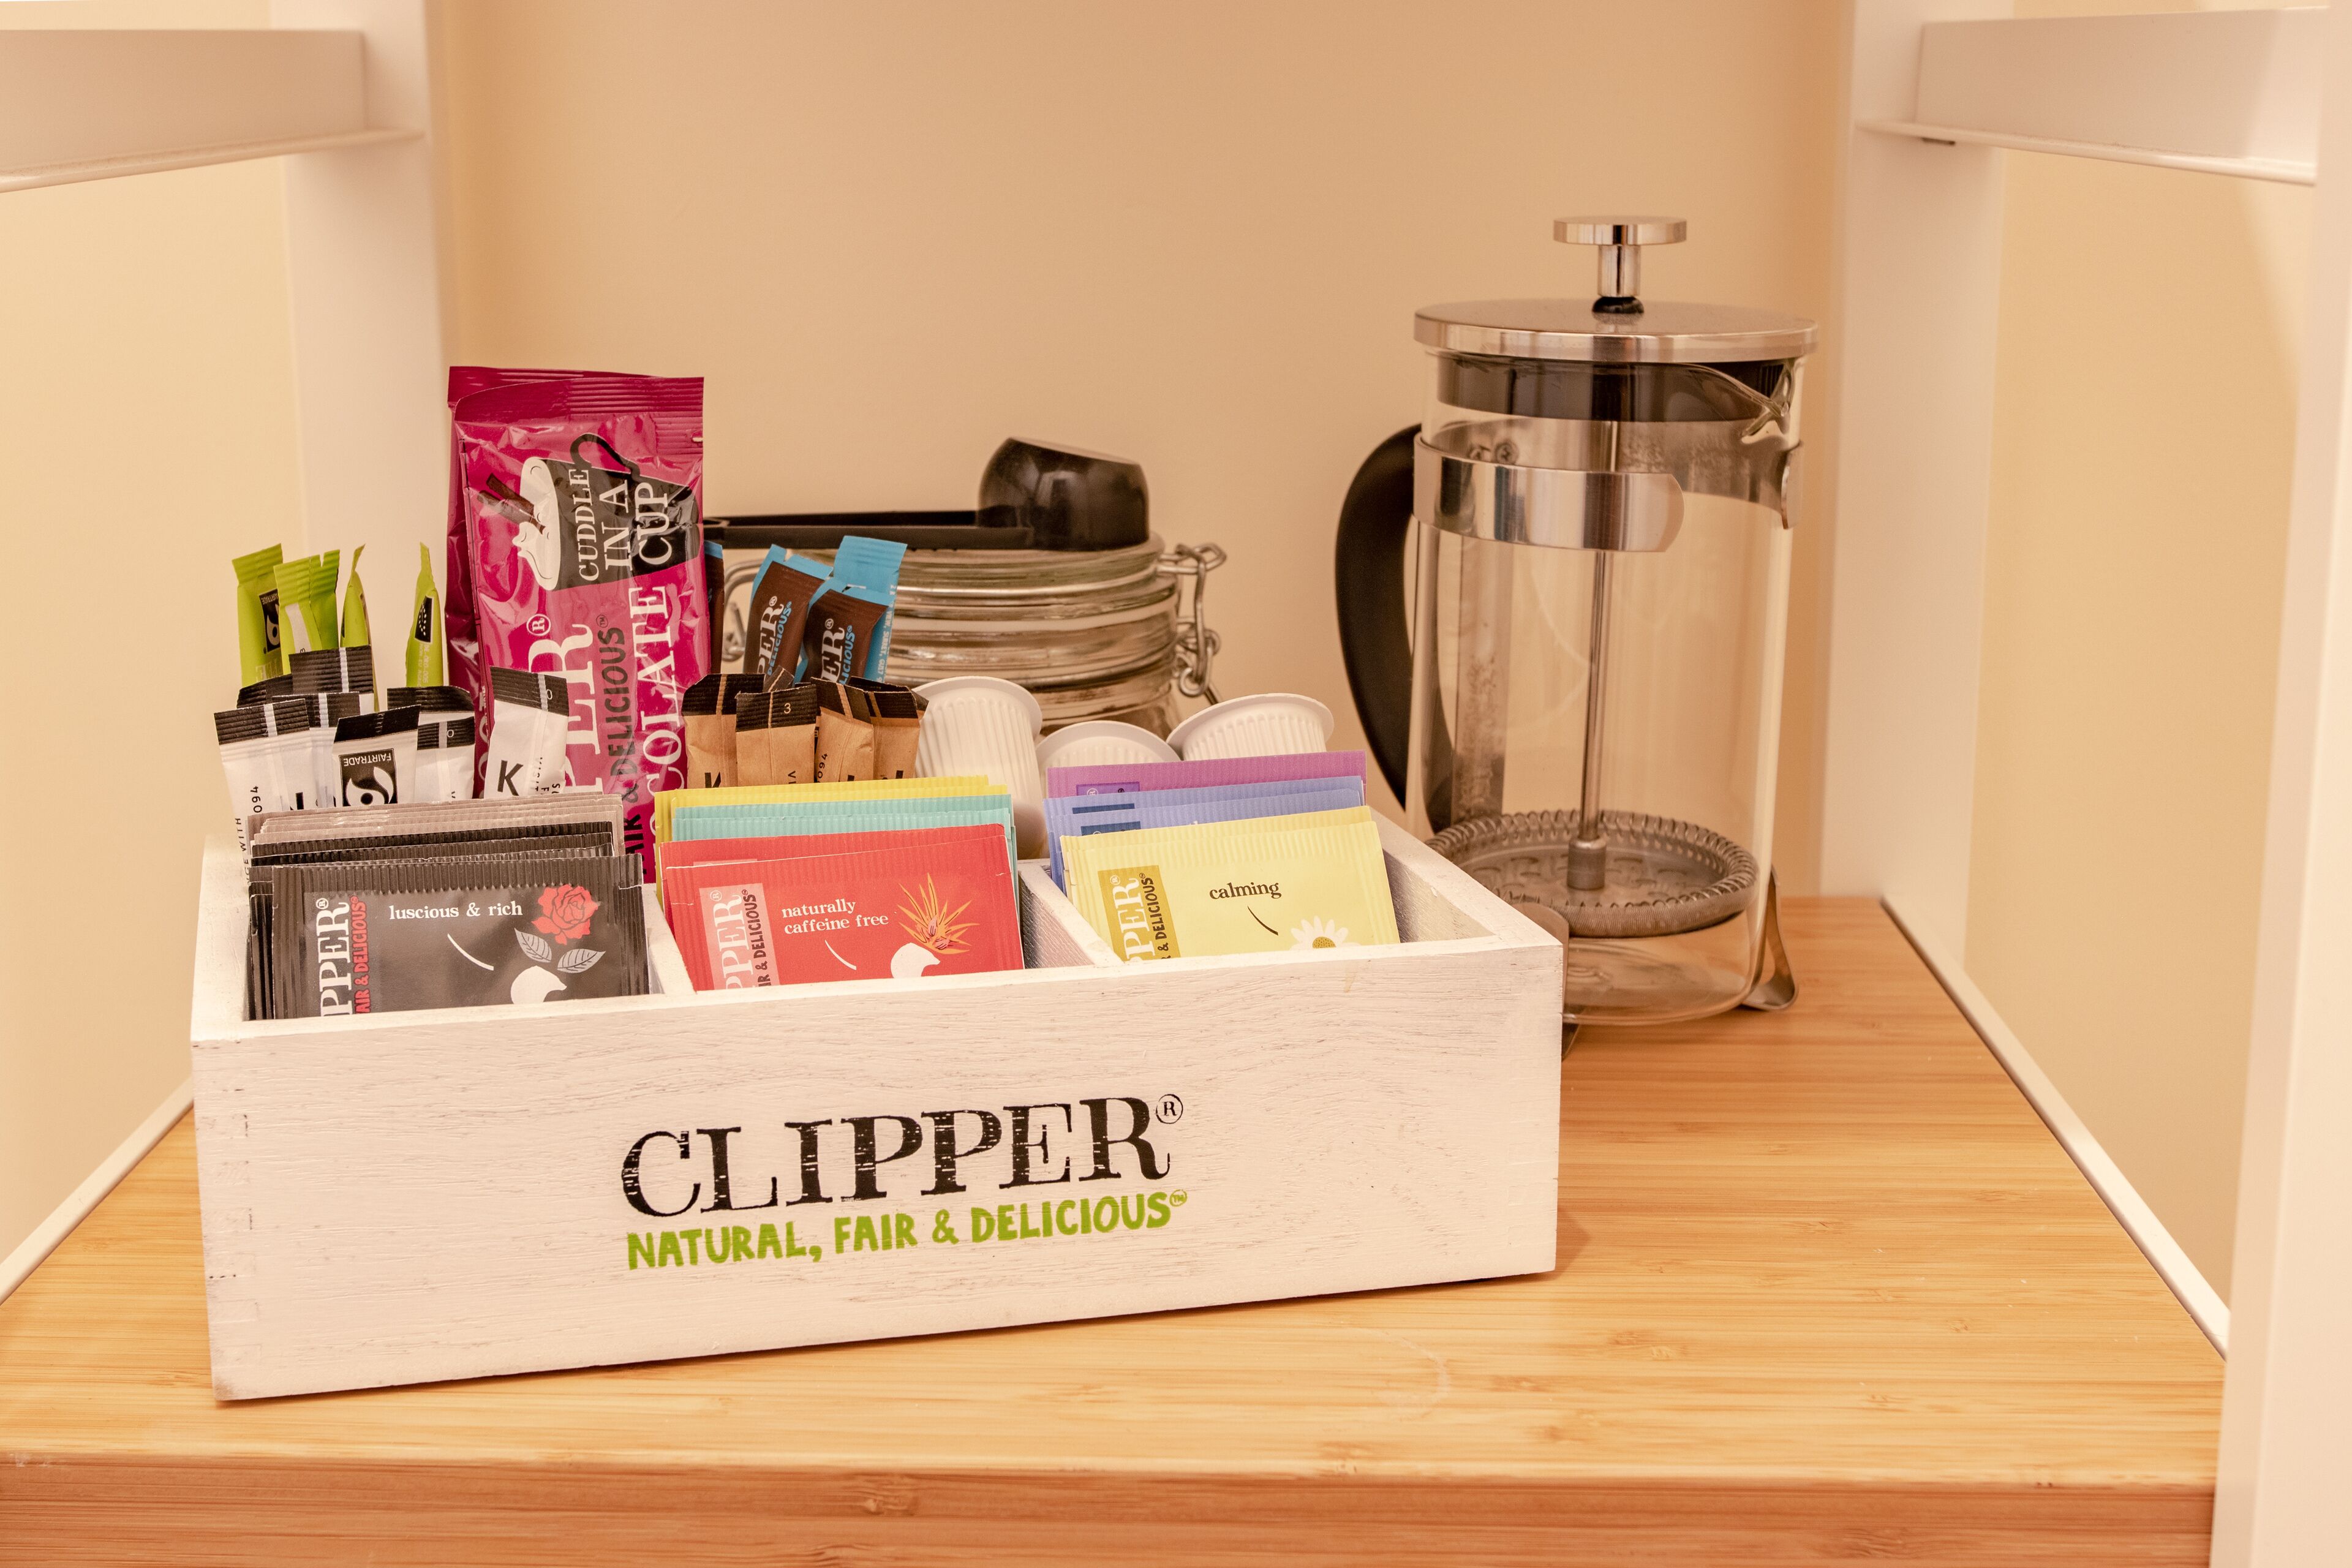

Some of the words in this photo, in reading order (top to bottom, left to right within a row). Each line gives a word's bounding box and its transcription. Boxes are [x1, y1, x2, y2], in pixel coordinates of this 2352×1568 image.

[599, 480, 628, 513] A
[568, 469, 600, 581] CUDDLE
[635, 481, 673, 565] CUP
[601, 521, 633, 571] IN
[783, 703, 791, 715] 3
[344, 753, 392, 766] FAIRTRADE
[817, 753, 829, 780] 094
[1209, 882, 1282, 899] calming
[389, 904, 459, 920] luscious
[466, 902, 481, 918] &
[488, 900, 522, 917] rich
[781, 898, 857, 918] naturally
[784, 917, 851, 935] caffeine
[855, 913, 889, 929] free
[1157, 942, 1169, 951] &
[755, 960, 768, 971] &
[625, 1221, 823, 1270] NATURAL,
[834, 1213, 918, 1254] FAIR
[932, 1209, 959, 1245] &
